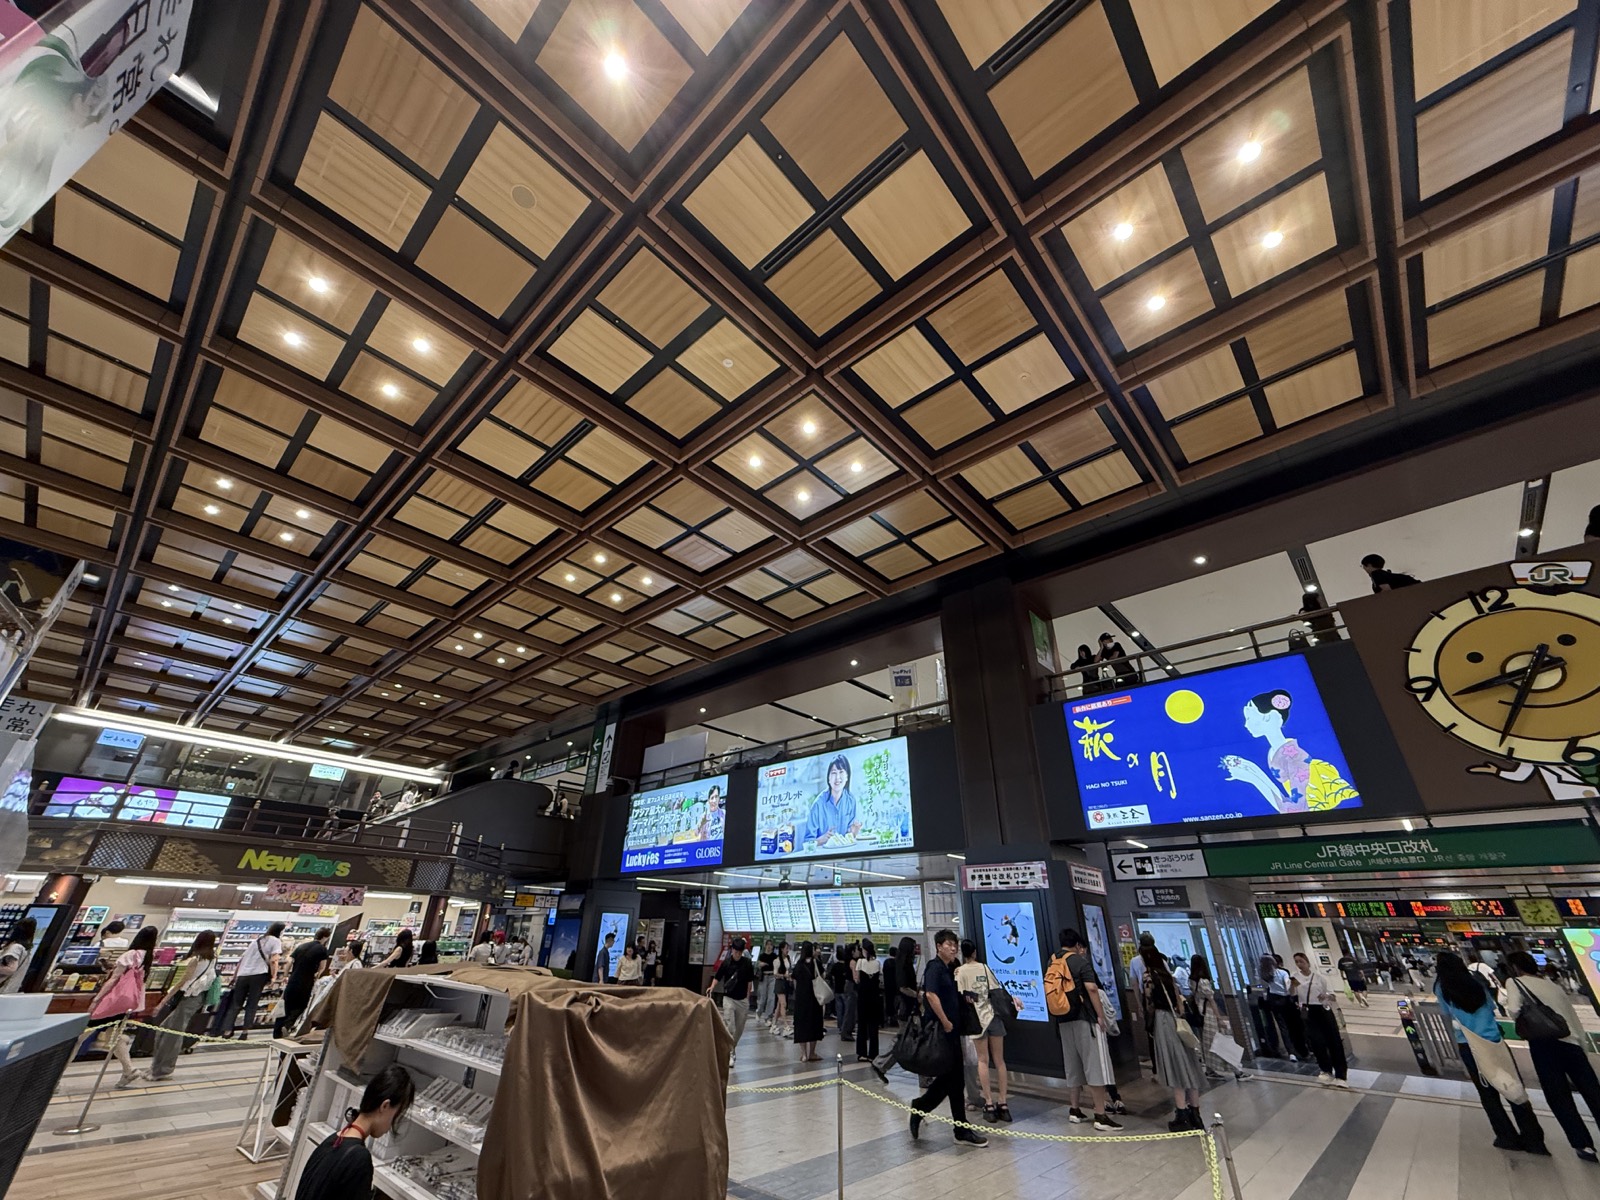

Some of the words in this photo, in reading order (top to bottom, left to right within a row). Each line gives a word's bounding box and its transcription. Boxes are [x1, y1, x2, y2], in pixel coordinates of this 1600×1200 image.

[1529, 568, 1571, 584] JR
[1467, 586, 1516, 615] 12
[1404, 676, 1439, 703] 9
[762, 790, 803, 805] ロイヤルブレッド
[695, 846, 721, 859] GLOBIS
[1316, 839, 1439, 858] JR線中央口改札
[237, 848, 351, 877] NewDays
[1153, 853, 1195, 864] きっぷうりば
[1270, 861, 1283, 870] JR
[1284, 860, 1303, 870] Line
[1304, 858, 1337, 869] Central
[1339, 858, 1362, 867] Gate
